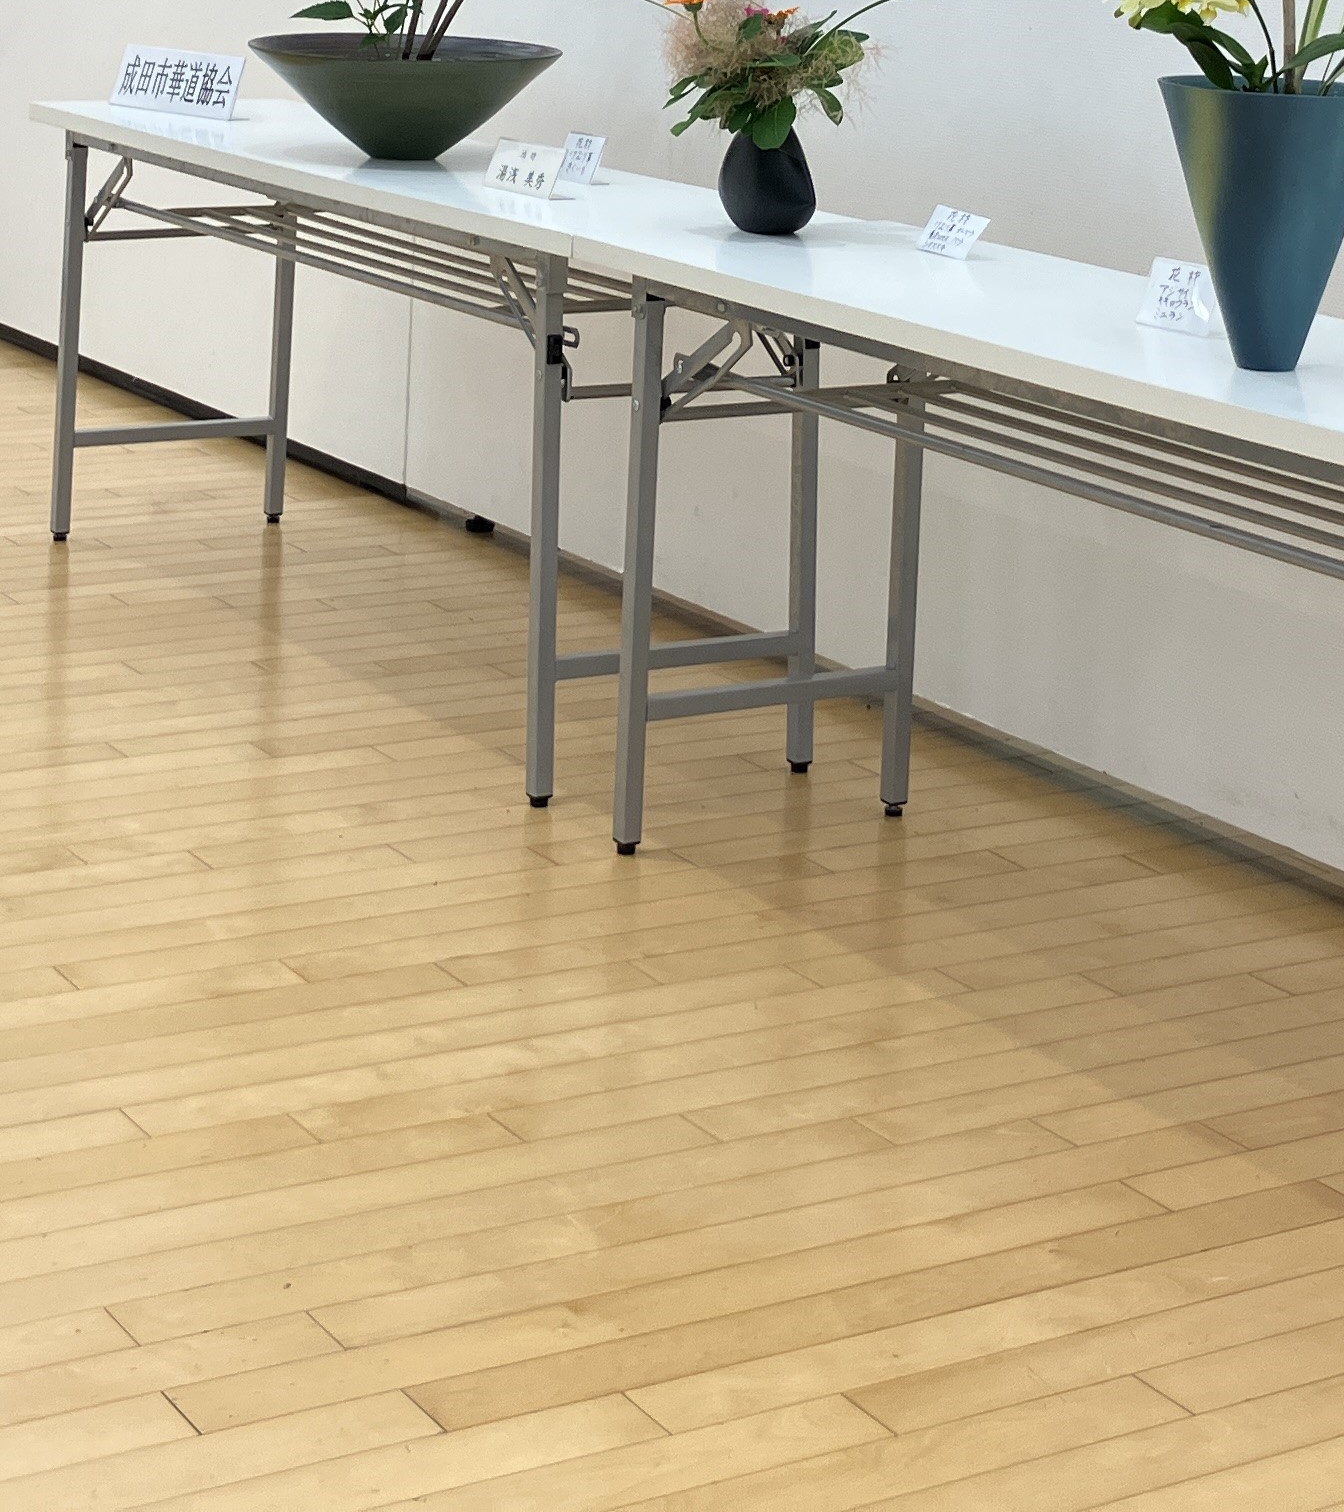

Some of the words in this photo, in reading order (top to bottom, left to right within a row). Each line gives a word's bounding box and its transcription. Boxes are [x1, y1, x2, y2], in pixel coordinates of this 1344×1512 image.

[118, 54, 233, 109] 成田市華道協会
